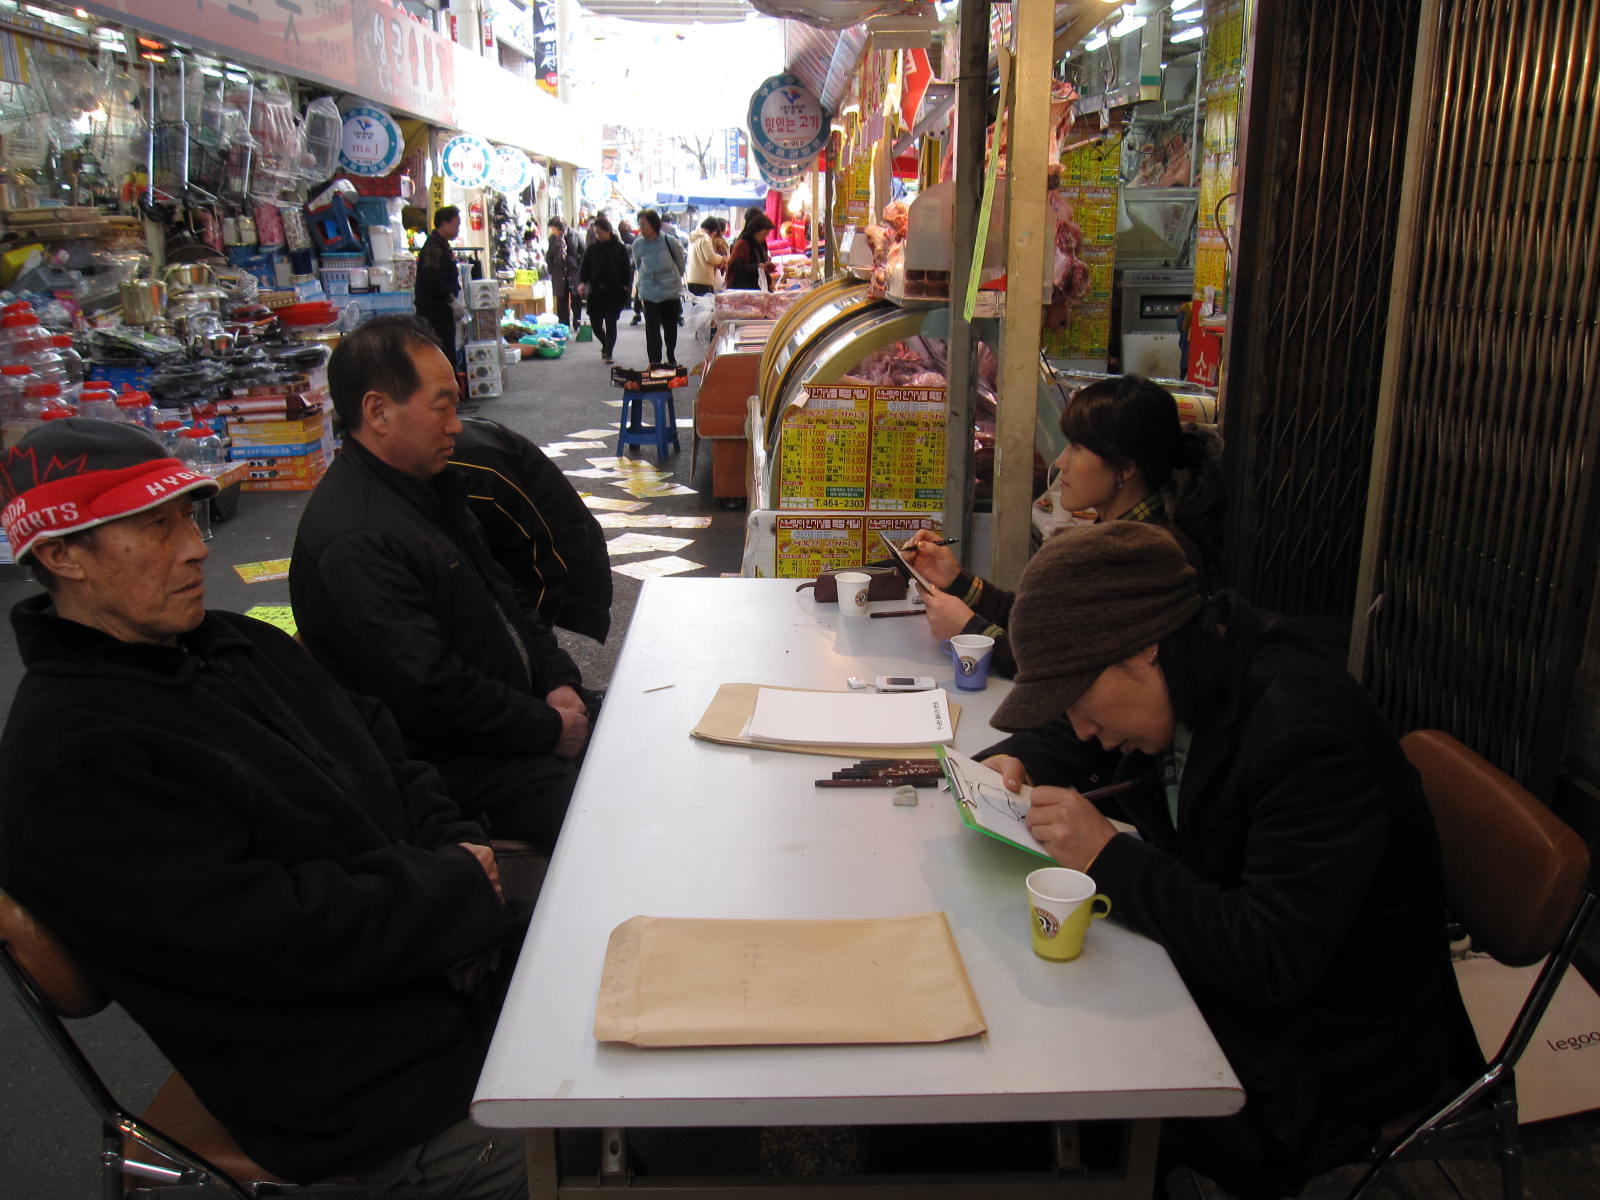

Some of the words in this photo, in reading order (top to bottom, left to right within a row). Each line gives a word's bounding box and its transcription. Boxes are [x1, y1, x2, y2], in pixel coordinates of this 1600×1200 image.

[764, 116, 797, 134] 맛있는
[799, 114, 819, 131] 고기
[815, 499, 865, 508] T.464-2303
[903, 500, 944, 509] T.464-23
[779, 519, 806, 530] 신년맞이
[806, 519, 831, 530] 인기상품
[868, 519, 894, 529] 신년맞이
[894, 519, 920, 530] 인기상품
